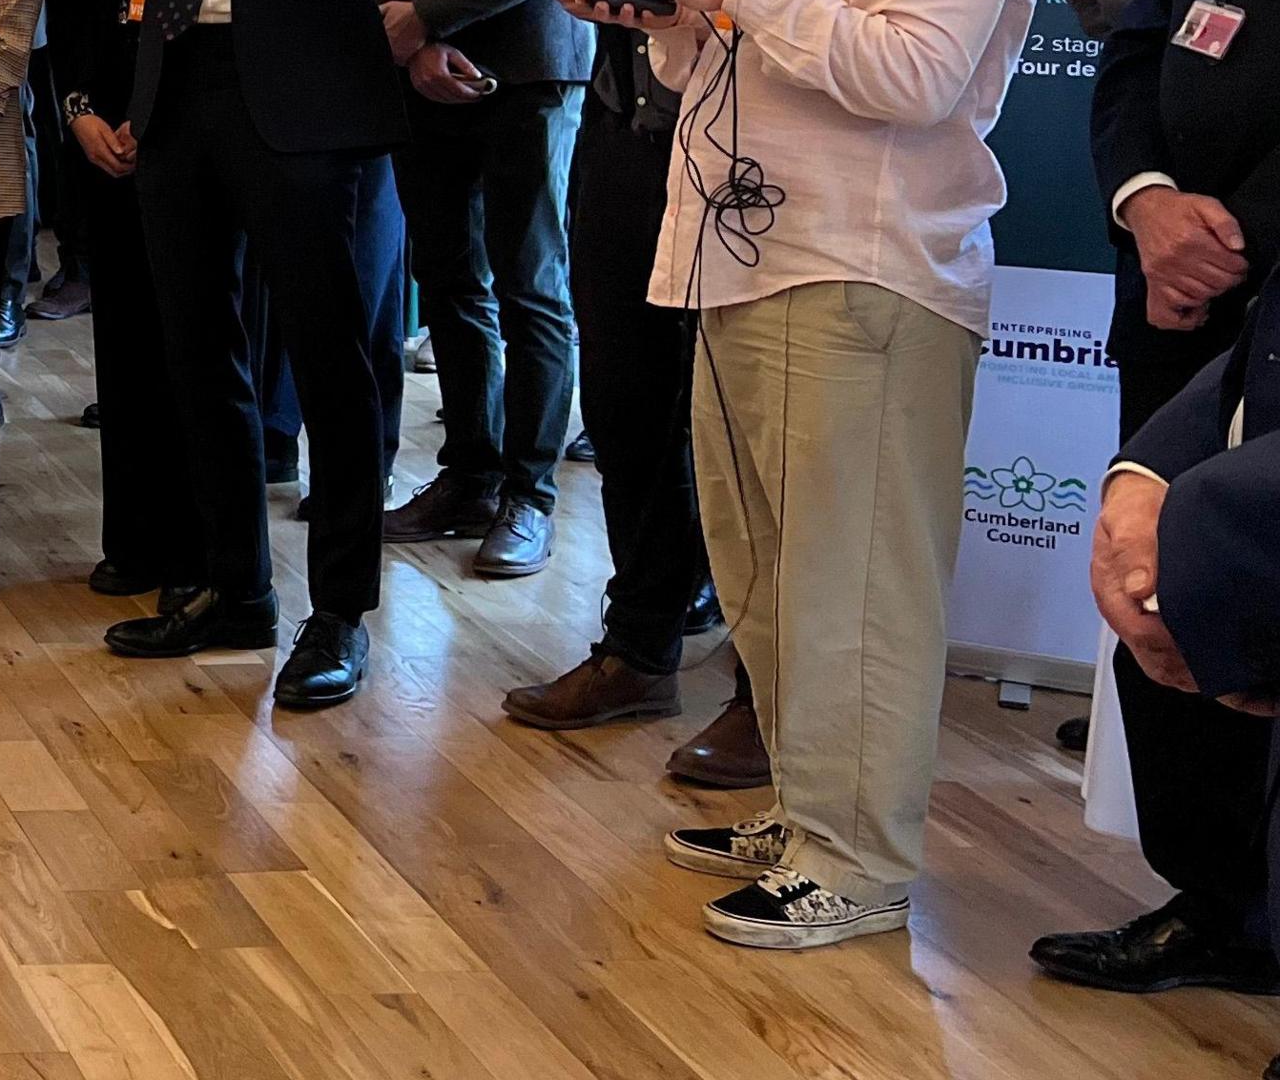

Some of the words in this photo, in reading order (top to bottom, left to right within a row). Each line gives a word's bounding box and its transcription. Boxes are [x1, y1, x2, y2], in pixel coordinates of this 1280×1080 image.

[1030, 34, 1044, 51] 2
[1052, 37, 1104, 57] stag
[1066, 60, 1097, 77] de
[991, 322, 1092, 339] ENTERPRISING
[998, 375, 1064, 389] INCLUSIVE
[964, 508, 1080, 535] Cumberland
[986, 528, 1056, 550] Council
